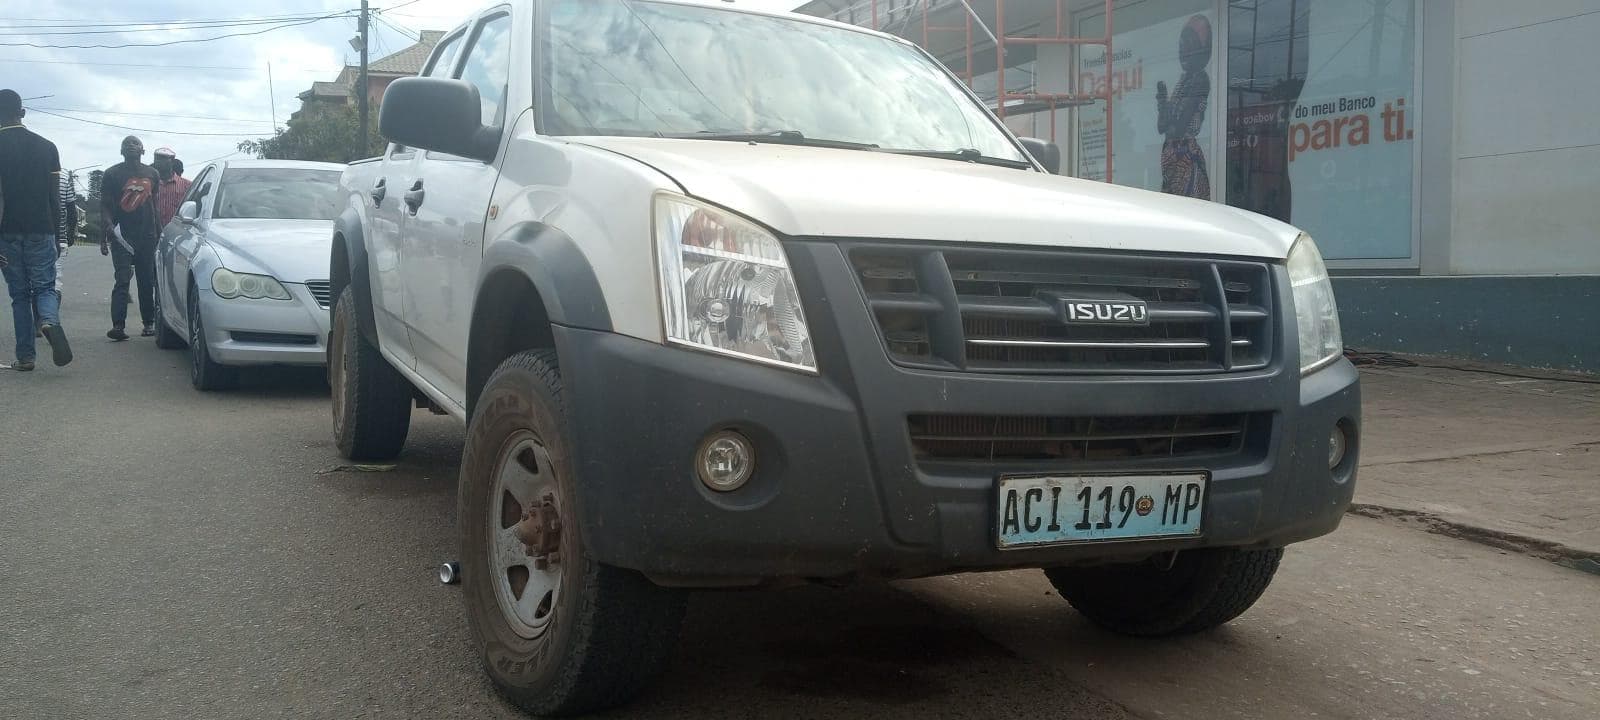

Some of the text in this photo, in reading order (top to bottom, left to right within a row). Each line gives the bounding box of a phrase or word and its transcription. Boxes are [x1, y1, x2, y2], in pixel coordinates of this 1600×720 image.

[1295, 96, 1376, 119] do meu Banco
[1288, 98, 1414, 162] para ti.
[1068, 303, 1146, 321] ISUZU
[1003, 483, 1201, 535] ACI 119 MP
